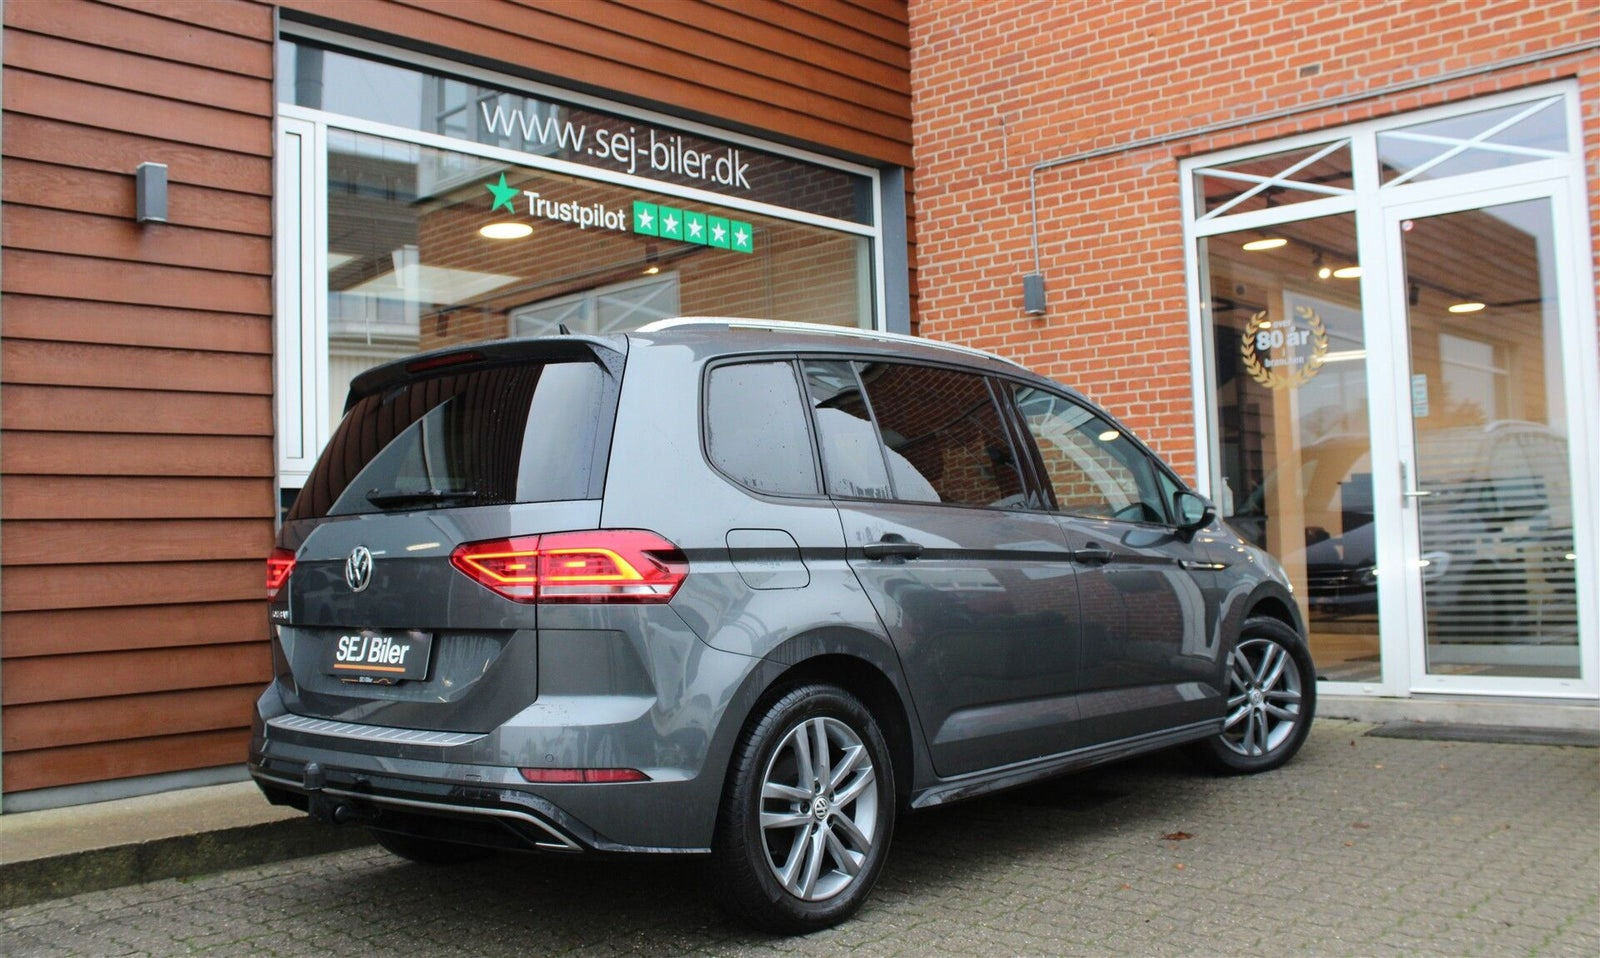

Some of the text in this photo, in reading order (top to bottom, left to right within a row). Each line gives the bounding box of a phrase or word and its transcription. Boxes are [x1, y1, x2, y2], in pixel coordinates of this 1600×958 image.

[481, 101, 751, 190] www.sej-biler.dk
[523, 190, 627, 231] Trustpilot
[1256, 326, 1310, 350] 80 år
[336, 635, 411, 665] SEJ Biler
